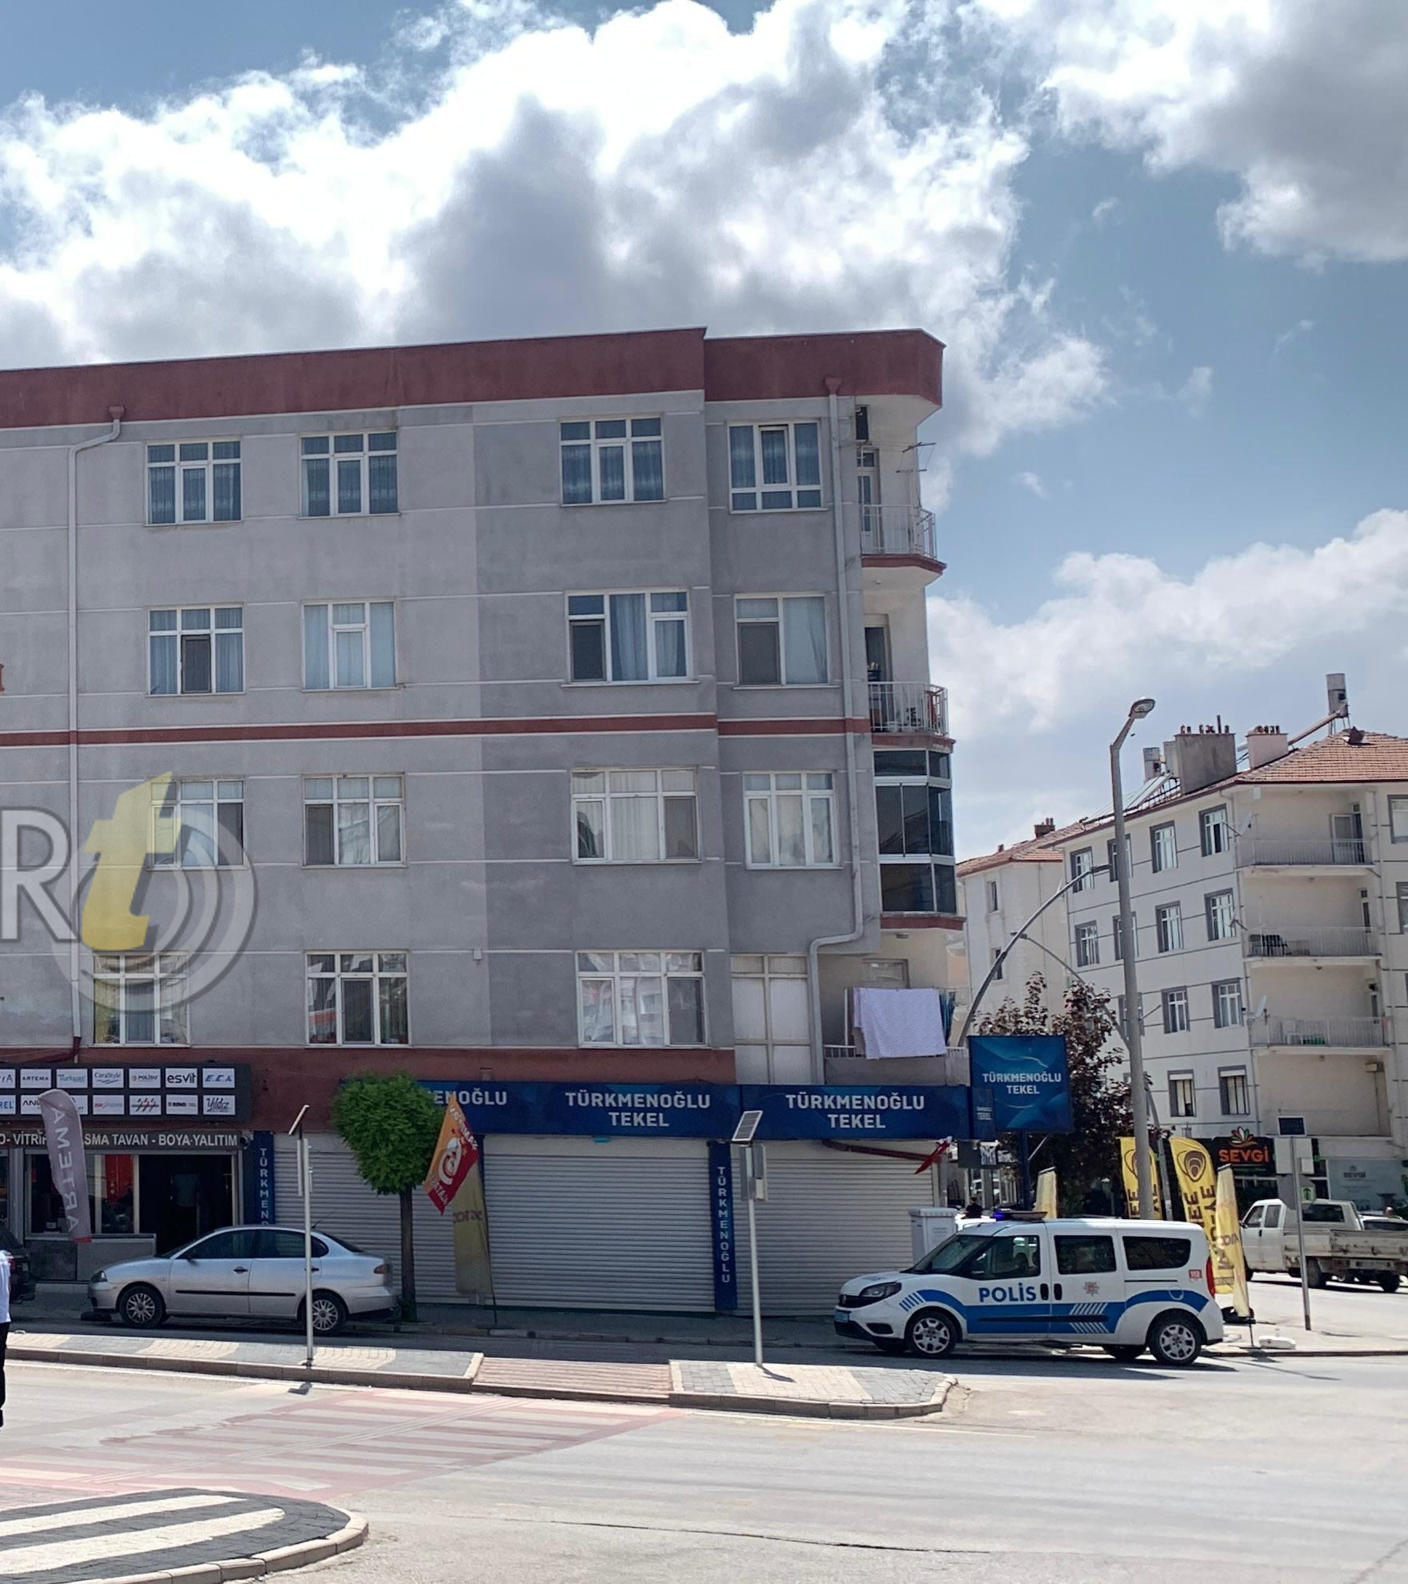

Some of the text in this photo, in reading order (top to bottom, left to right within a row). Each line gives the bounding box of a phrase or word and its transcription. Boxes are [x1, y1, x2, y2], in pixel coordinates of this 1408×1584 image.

[167, 1072, 196, 1084] esvit
[982, 1071, 1062, 1083] TÜRKMENOĞLU
[434, 1087, 507, 1105] ENOĞLU
[1006, 1085, 1040, 1095] TEKEL
[565, 1089, 711, 1109] TÜRKMENOĞLU
[786, 1091, 925, 1110] TÜRKMENOĞLU
[608, 1111, 670, 1127] TEKEL
[827, 1113, 886, 1129] TEKEL
[84, 1133, 109, 1146] SMA
[113, 1133, 148, 1146] TAVAN
[1218, 1146, 1269, 1163] SEVGİ
[717, 1166, 730, 1283] TÜRKMENOĞLU
[979, 1281, 1037, 1302] POLİS
